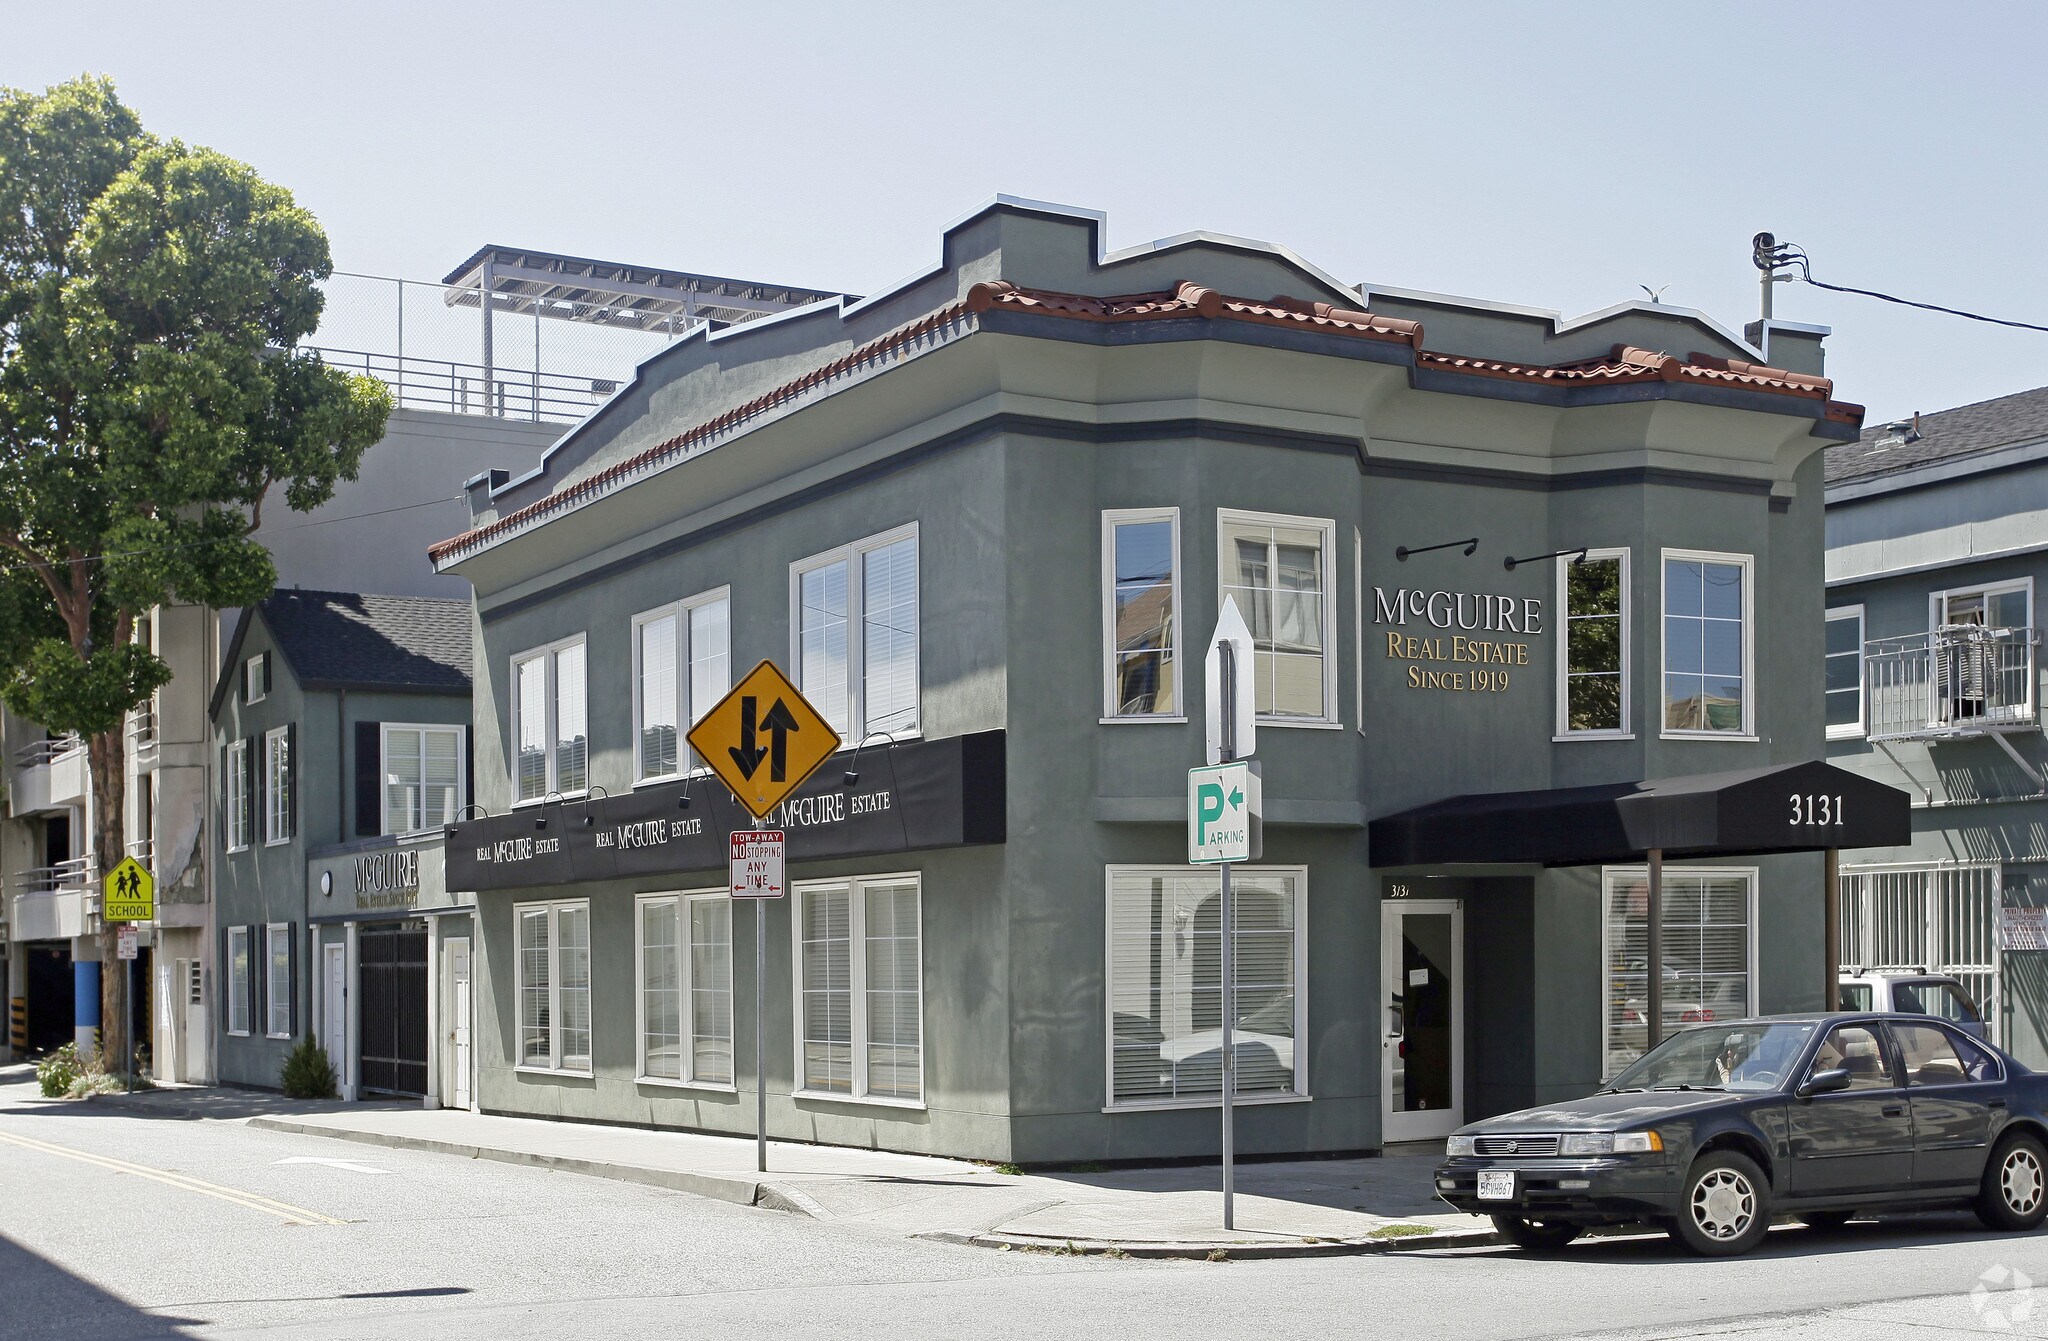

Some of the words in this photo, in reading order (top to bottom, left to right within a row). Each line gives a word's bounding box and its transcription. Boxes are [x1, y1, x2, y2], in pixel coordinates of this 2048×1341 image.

[1373, 586, 1543, 634] McGUIRE
[1386, 631, 1448, 660] REAL
[1451, 635, 1529, 665] ESTATE
[1407, 665, 1464, 690] SINCE
[1469, 669, 1509, 692] 1919
[780, 792, 846, 828] McGUIRE
[851, 791, 891, 814] ESTATE
[1789, 794, 1844, 826] 3131
[596, 832, 615, 848] REAL
[617, 819, 668, 850] McGUIRE
[671, 818, 702, 838] ESTATE
[734, 833, 780, 842] TOW-AWAY
[476, 847, 492, 862] REAL
[493, 837, 533, 864] McGUIRE
[535, 838, 560, 855] ESTATE
[732, 843, 746, 859] NO
[747, 846, 781, 858] STOPPING
[354, 850, 418, 892] McGUIRE
[746, 874, 768, 886] TIME
[747, 861, 767, 873] ANY
[1391, 884, 1409, 897] 3131
[108, 905, 149, 917] SCHOOL
